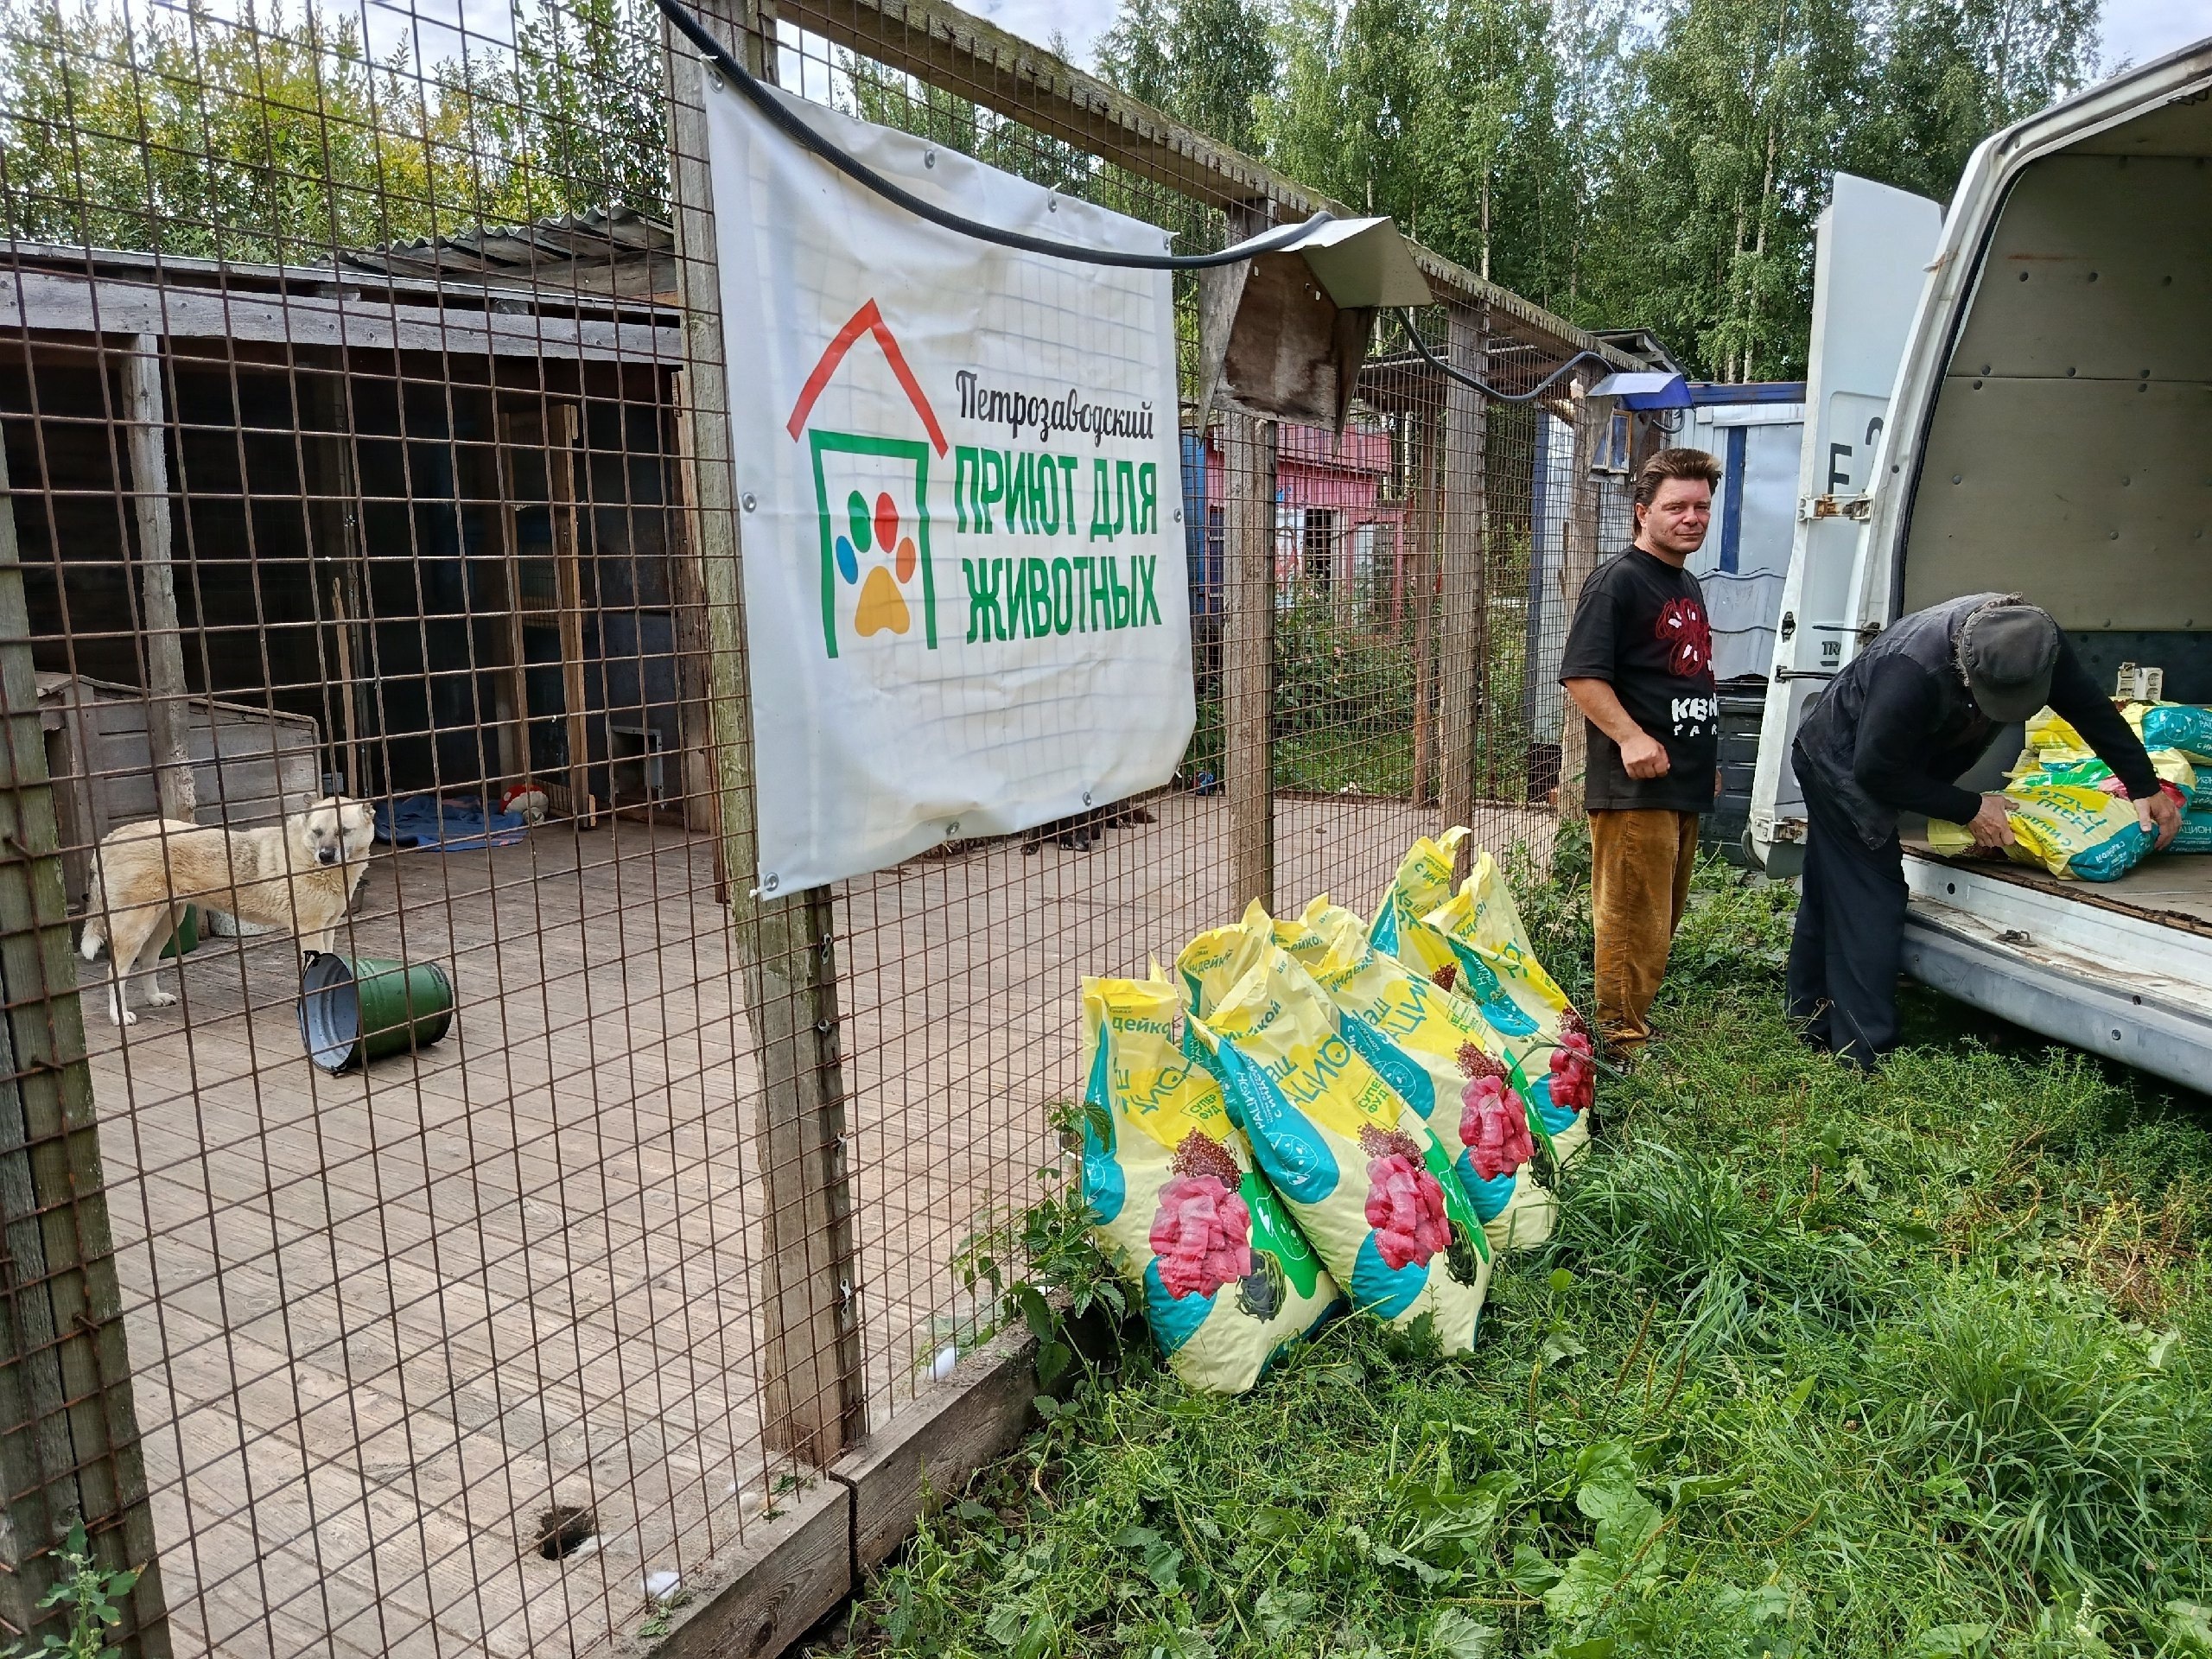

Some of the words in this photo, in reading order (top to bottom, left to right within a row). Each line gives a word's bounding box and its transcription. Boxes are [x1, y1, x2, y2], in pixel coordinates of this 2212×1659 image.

[956, 370, 1154, 448] Петрозаводский
[954, 446, 1078, 537] ПРИЮТ
[1090, 458, 1158, 543] ДЛЯ
[962, 555, 1162, 645] ЖИВОТНЫХ
[1821, 640, 1841, 656] TR
[1671, 693, 1719, 722] KEN
[1673, 724, 1718, 737] PAR
[2011, 810, 2062, 839] индей
[2178, 825, 2212, 835] АЦИОН
[1397, 909, 1422, 932] РА
[1330, 944, 1375, 993] индейко
[1352, 997, 1391, 1027] аш
[1263, 1055, 1299, 1084] аш
[1189, 1094, 1217, 1115] СУПЕР
[1198, 1105, 1223, 1121] ФУД
[1368, 1087, 1390, 1114] ФУД
